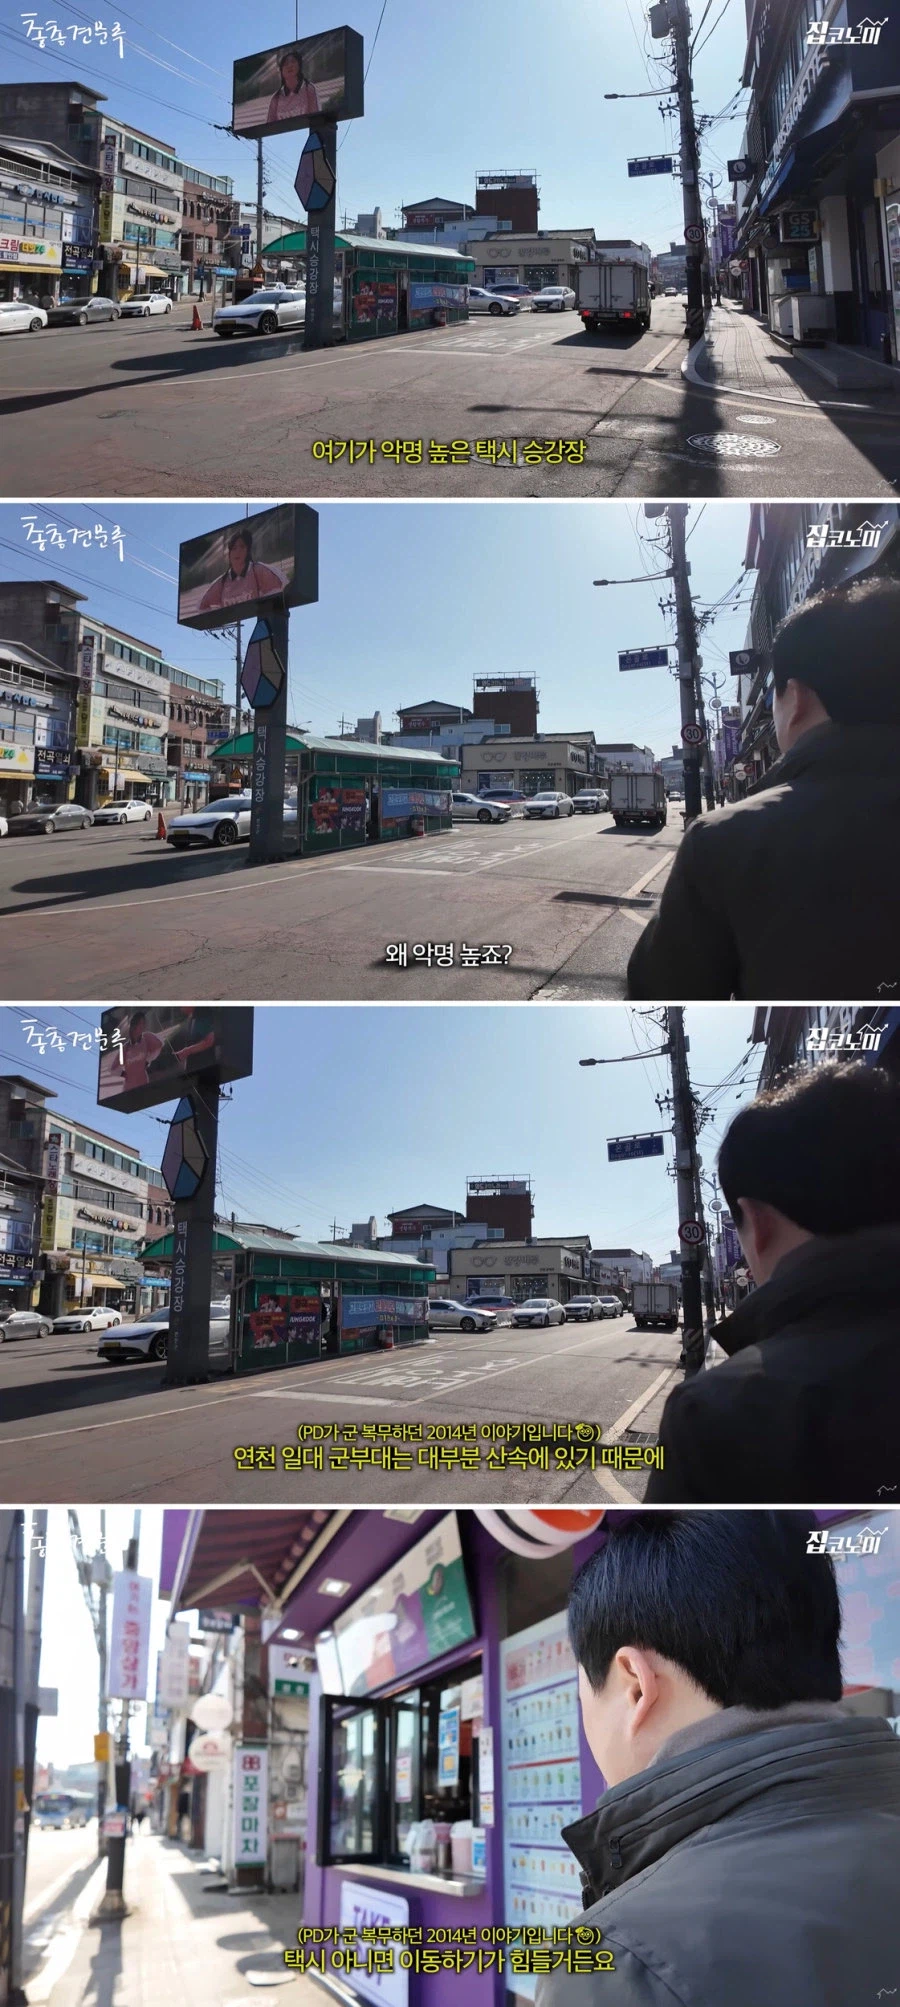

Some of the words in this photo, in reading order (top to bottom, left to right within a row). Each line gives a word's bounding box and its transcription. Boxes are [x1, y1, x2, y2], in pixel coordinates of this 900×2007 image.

[789, 213, 811, 225] GS
[688, 227, 702, 240] 30
[789, 225, 811, 237] 25
[306, 226, 319, 295] 택시승강장
[686, 726, 700, 740] 30
[37, 749, 71, 766] 전곡열쇠
[256, 725, 268, 803] 택시승강장
[684, 1225, 700, 1240] 30
[173, 1221, 188, 1313] 택시승강장
[240, 1774, 260, 1854] 포장마차
